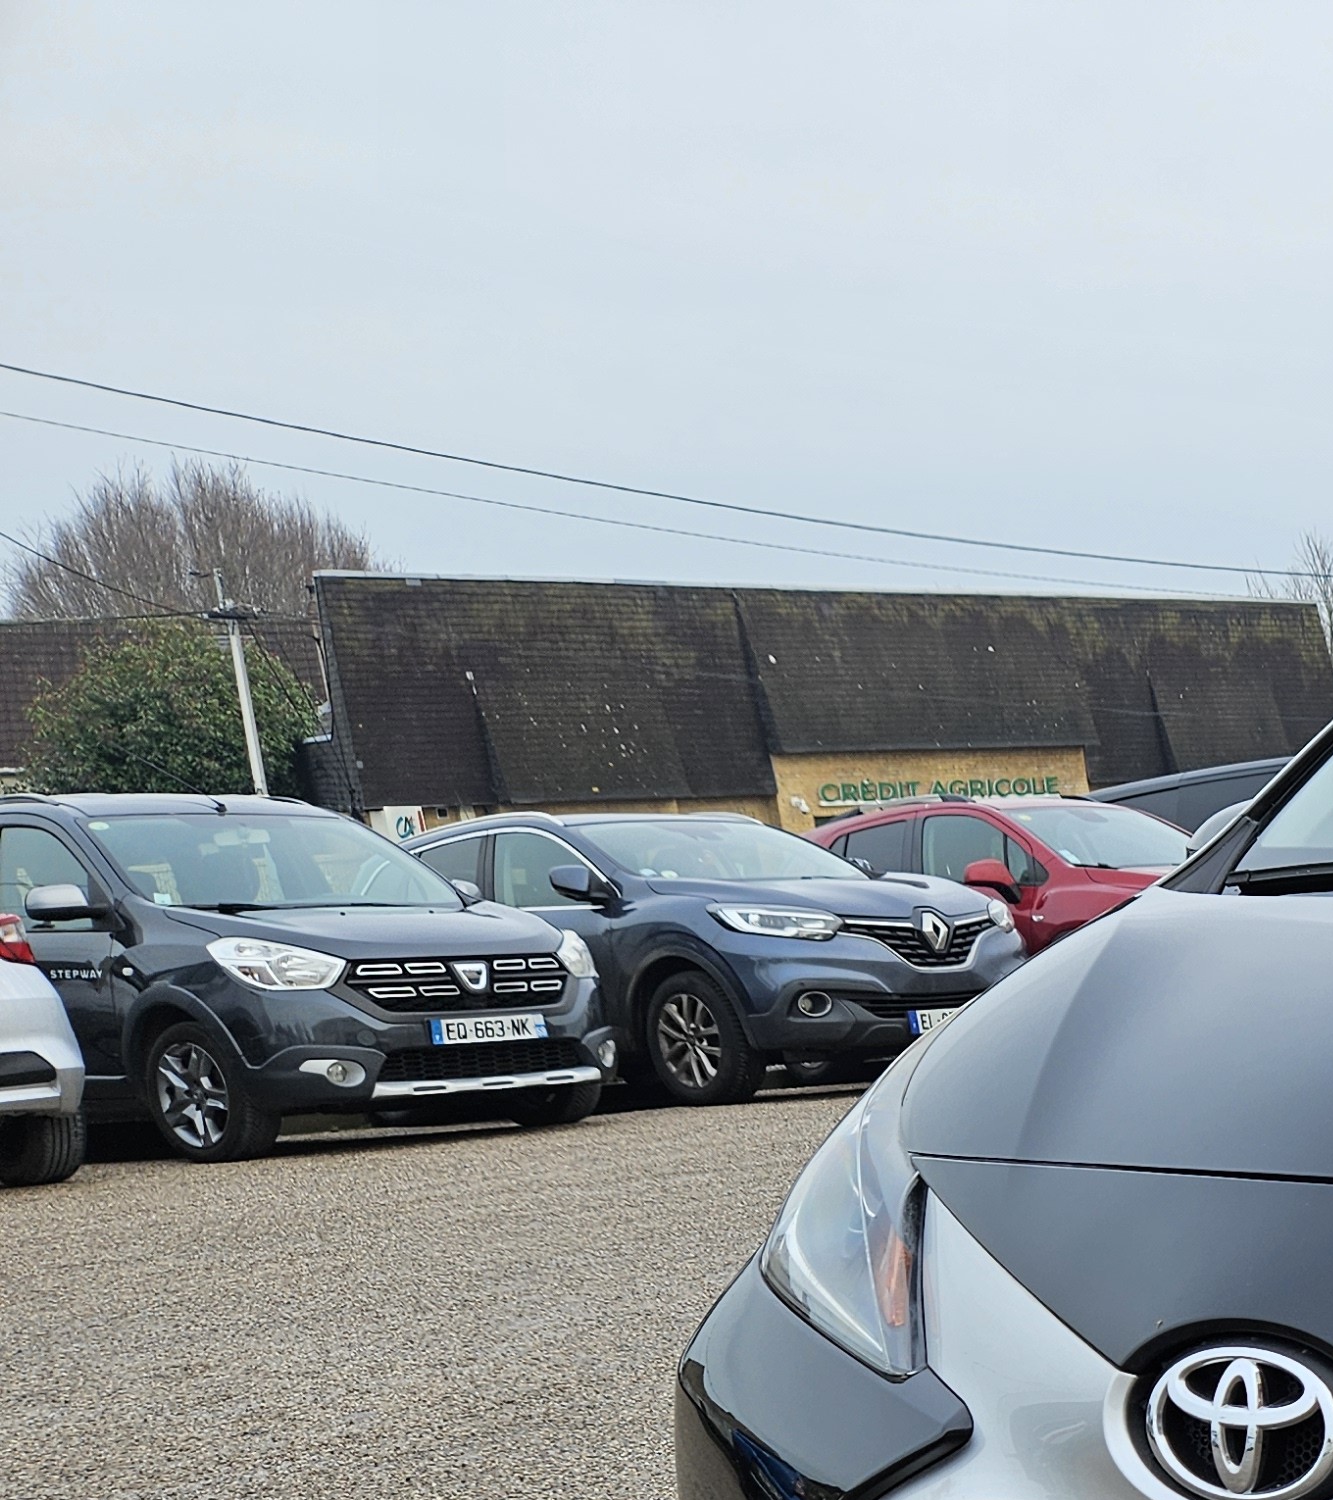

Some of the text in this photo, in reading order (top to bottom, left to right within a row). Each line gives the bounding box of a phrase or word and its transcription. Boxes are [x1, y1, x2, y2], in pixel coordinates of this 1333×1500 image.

[931, 776, 1060, 798] AGRICOLE
[50, 969, 103, 979] STEPWAY
[445, 1018, 532, 1041] EQ-663-NK
